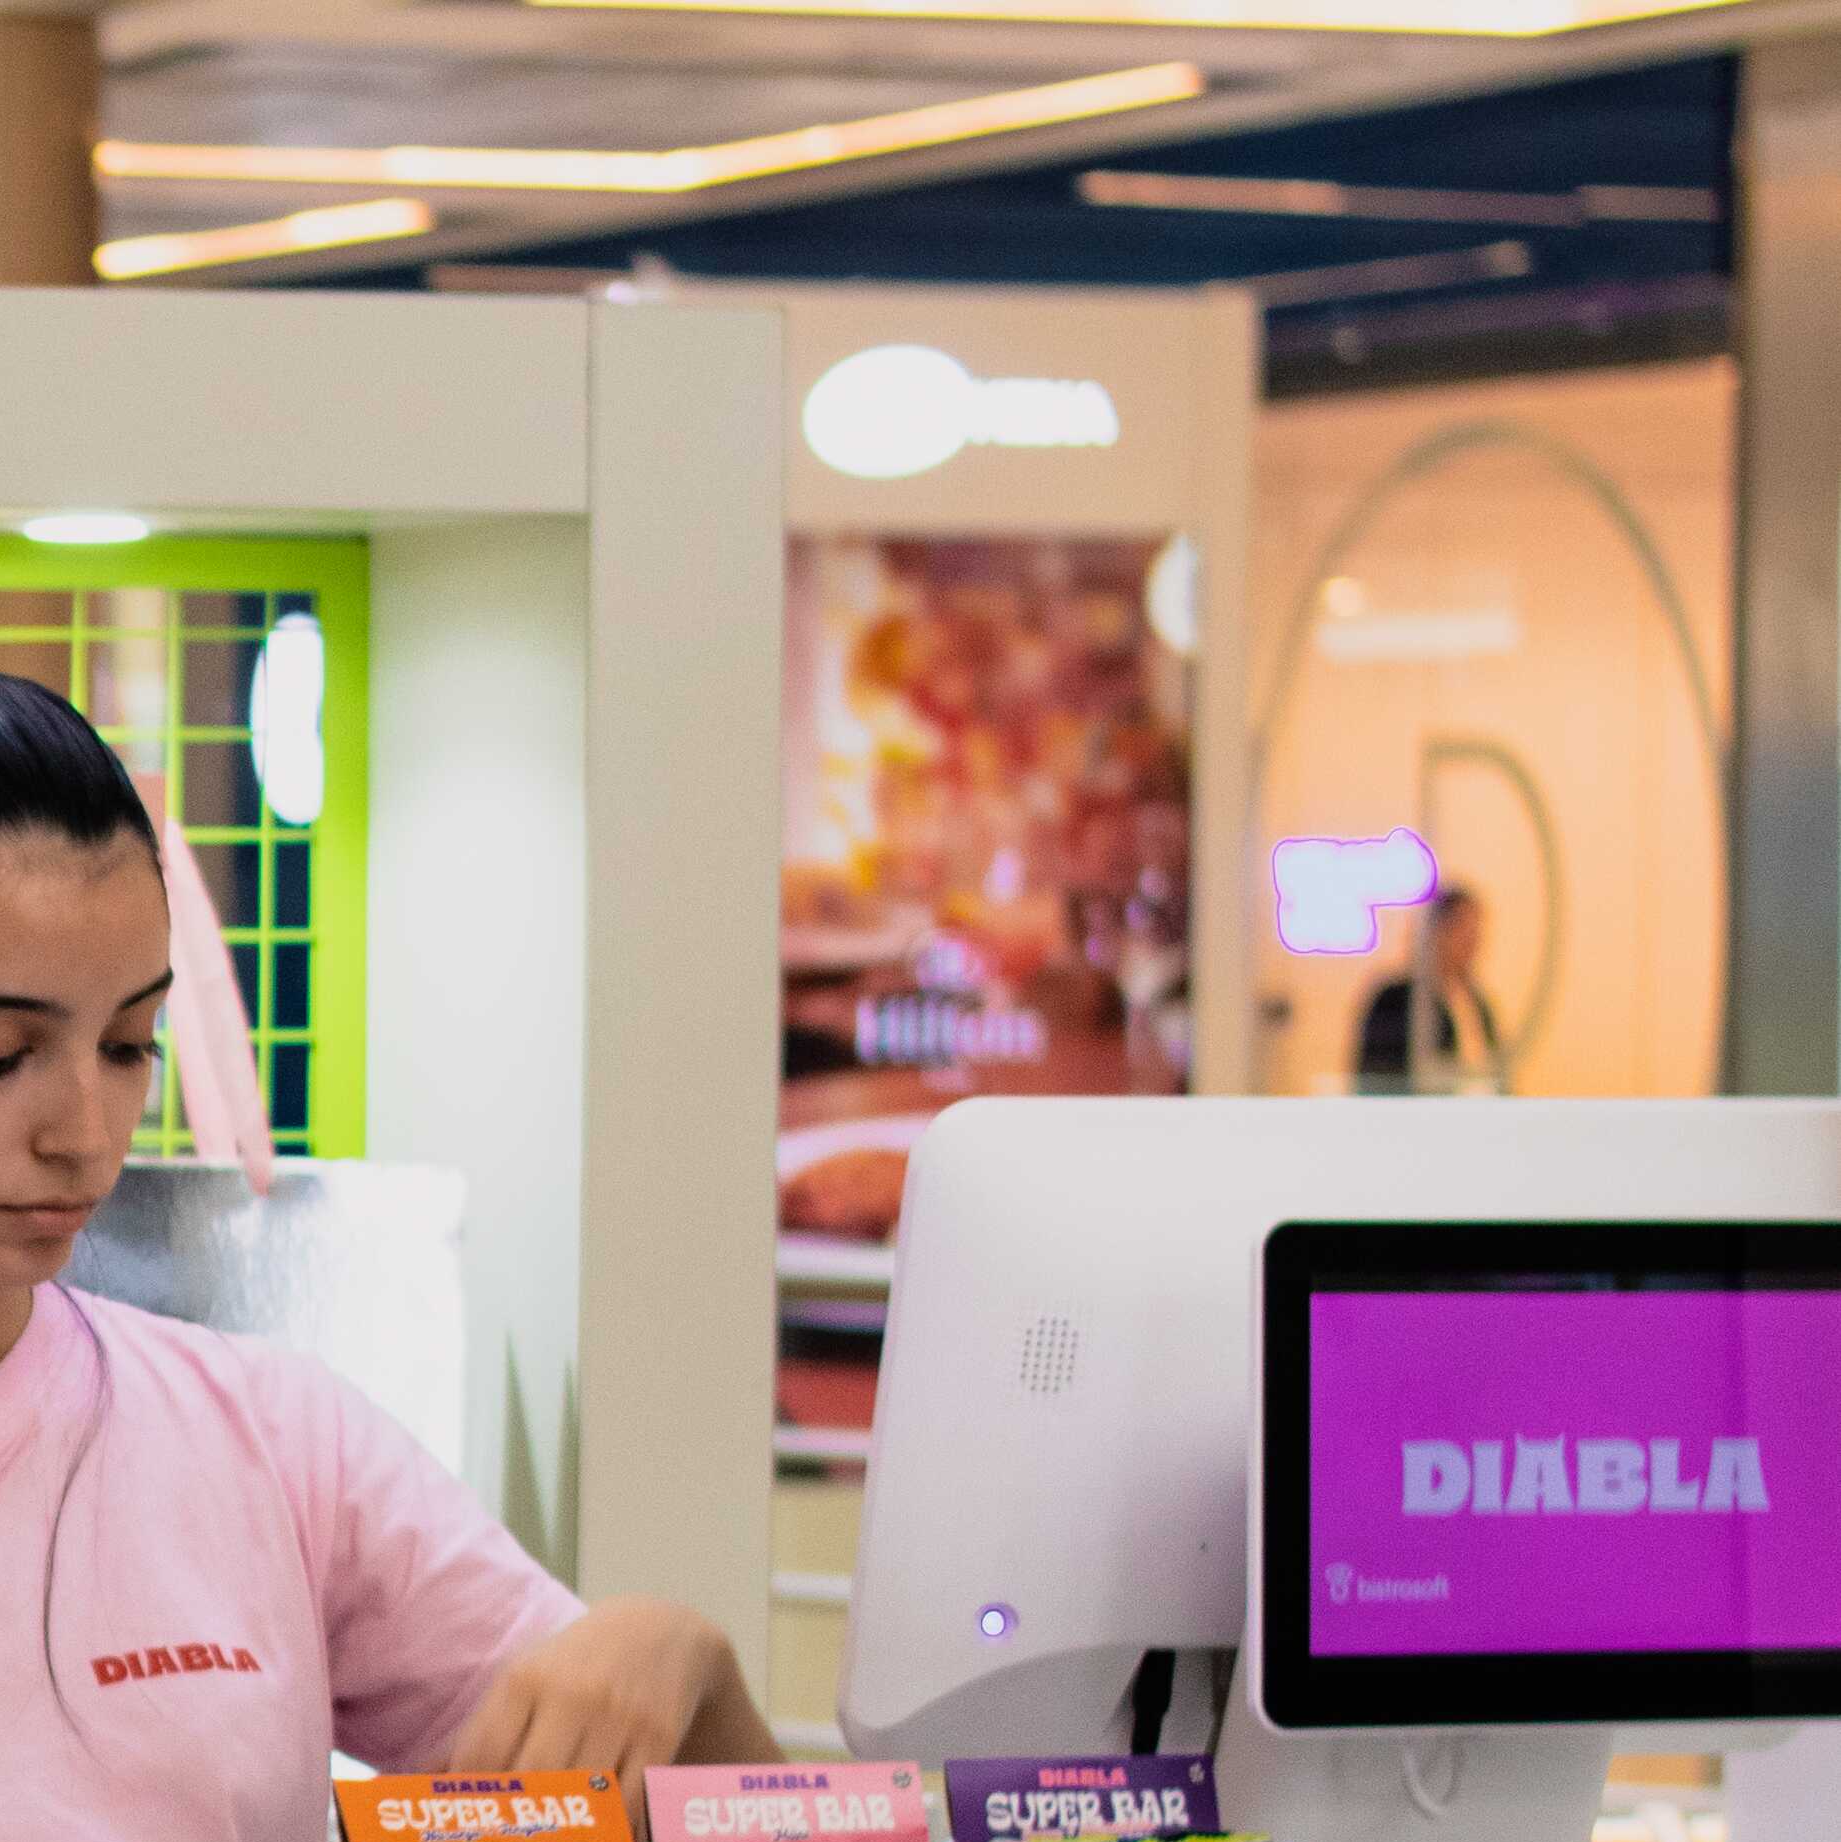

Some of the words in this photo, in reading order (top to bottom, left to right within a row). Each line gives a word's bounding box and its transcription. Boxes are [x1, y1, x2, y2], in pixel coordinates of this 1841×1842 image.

[1401, 1432, 1769, 1516] DIABLA
[90, 1642, 262, 1687] DIABLA
[432, 1780, 524, 1794] DIABLA
[740, 1773, 829, 1790] DIABLA
[1038, 1767, 1128, 1788] DIABLA
[377, 1798, 506, 1832] SUPER
[516, 1794, 595, 1828] BAR
[684, 1797, 808, 1834] SUPER
[816, 1797, 895, 1831] BAR
[986, 1788, 1105, 1833] SUPER
[1110, 1787, 1190, 1831] BAR
